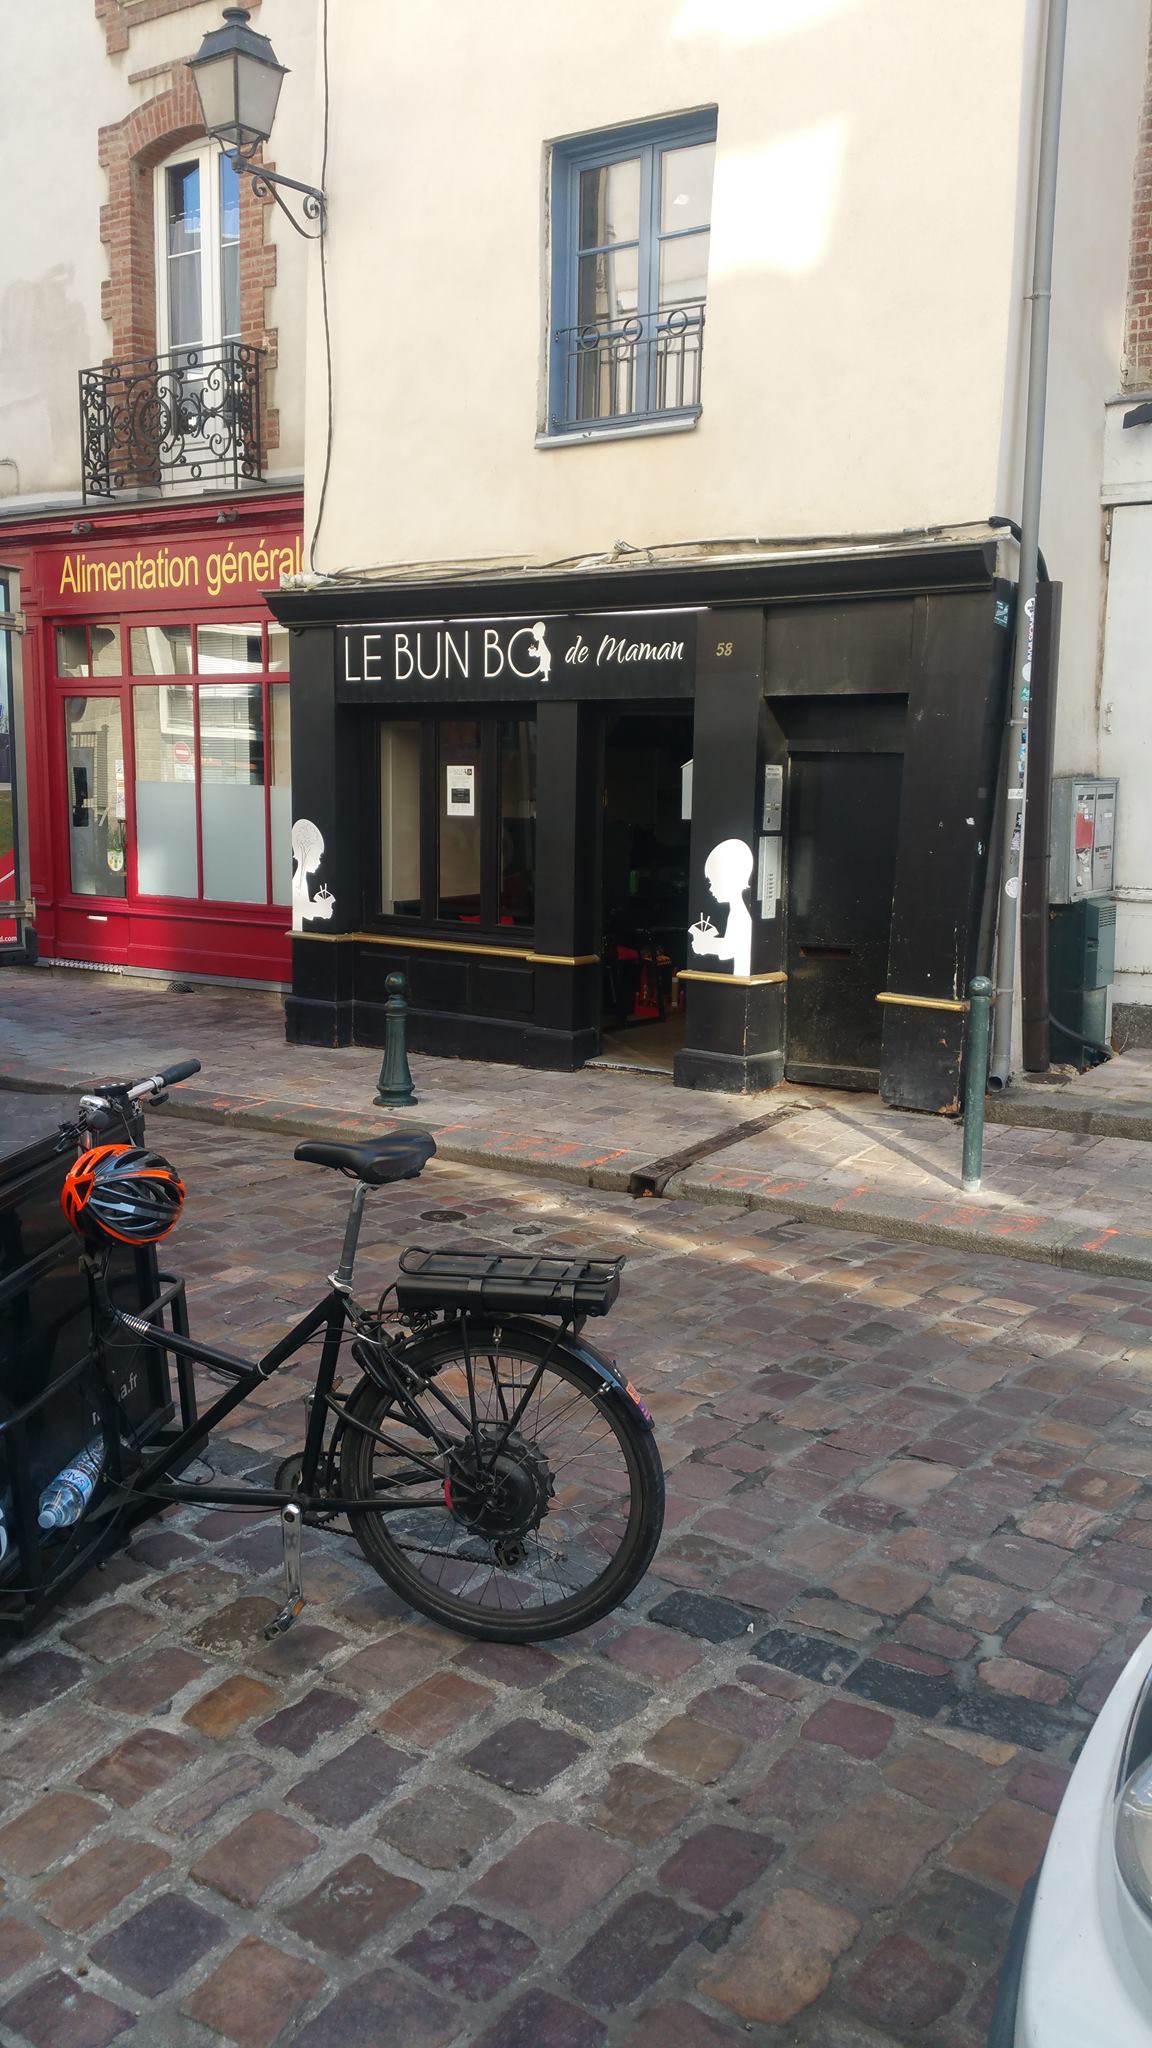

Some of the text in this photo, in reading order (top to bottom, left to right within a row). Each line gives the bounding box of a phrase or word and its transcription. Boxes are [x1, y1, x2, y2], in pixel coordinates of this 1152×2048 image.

[59, 535, 305, 596] Alimentation général
[345, 634, 382, 681] LE
[394, 630, 469, 680] BUN
[564, 635, 589, 665] de
[596, 634, 685, 666] Maman
[716, 642, 733, 656] 58
